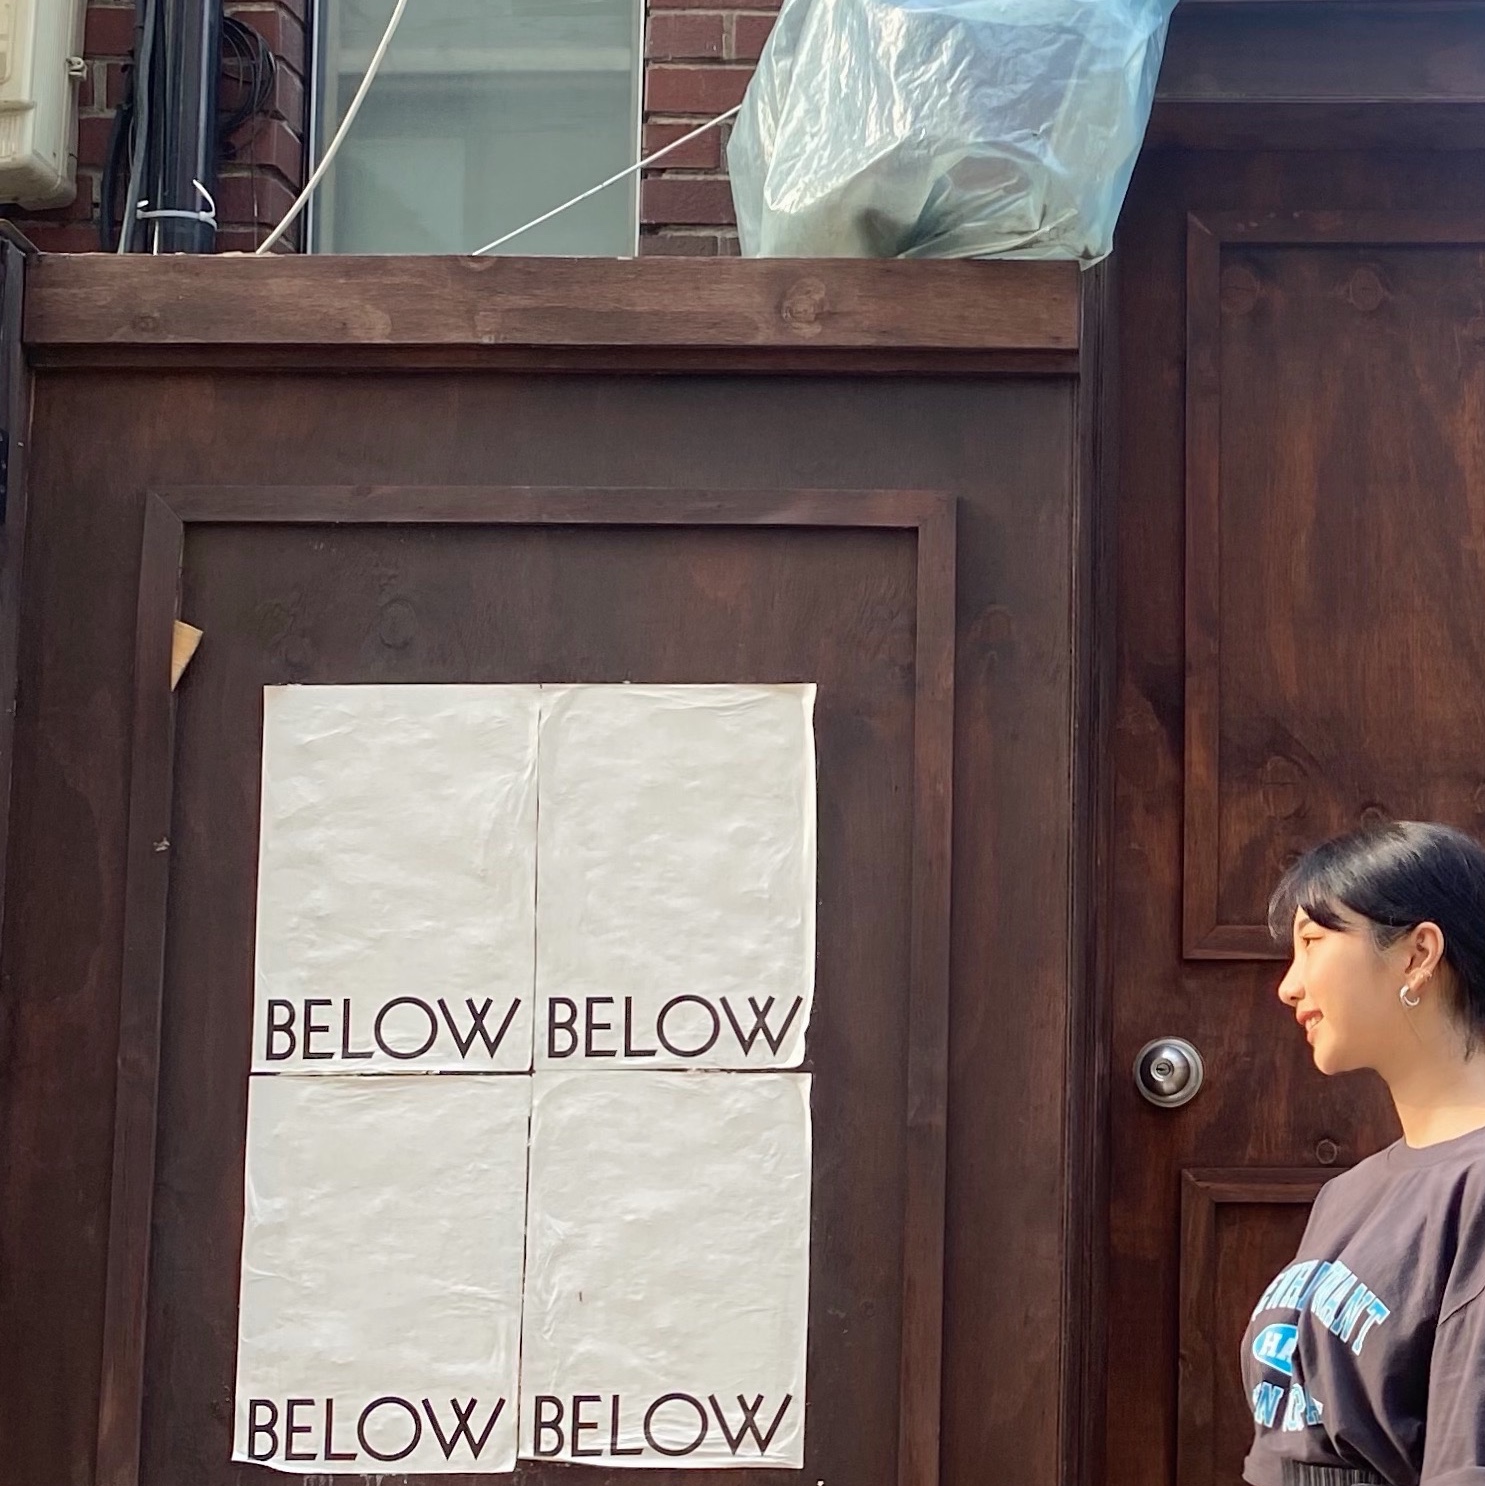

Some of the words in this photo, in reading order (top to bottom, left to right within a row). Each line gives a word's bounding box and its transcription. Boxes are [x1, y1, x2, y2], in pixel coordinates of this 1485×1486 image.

[265, 996, 521, 1061] BELOW
[547, 994, 804, 1058] BELOW
[247, 1396, 506, 1462] BELOW
[533, 1392, 793, 1458] BELOW
